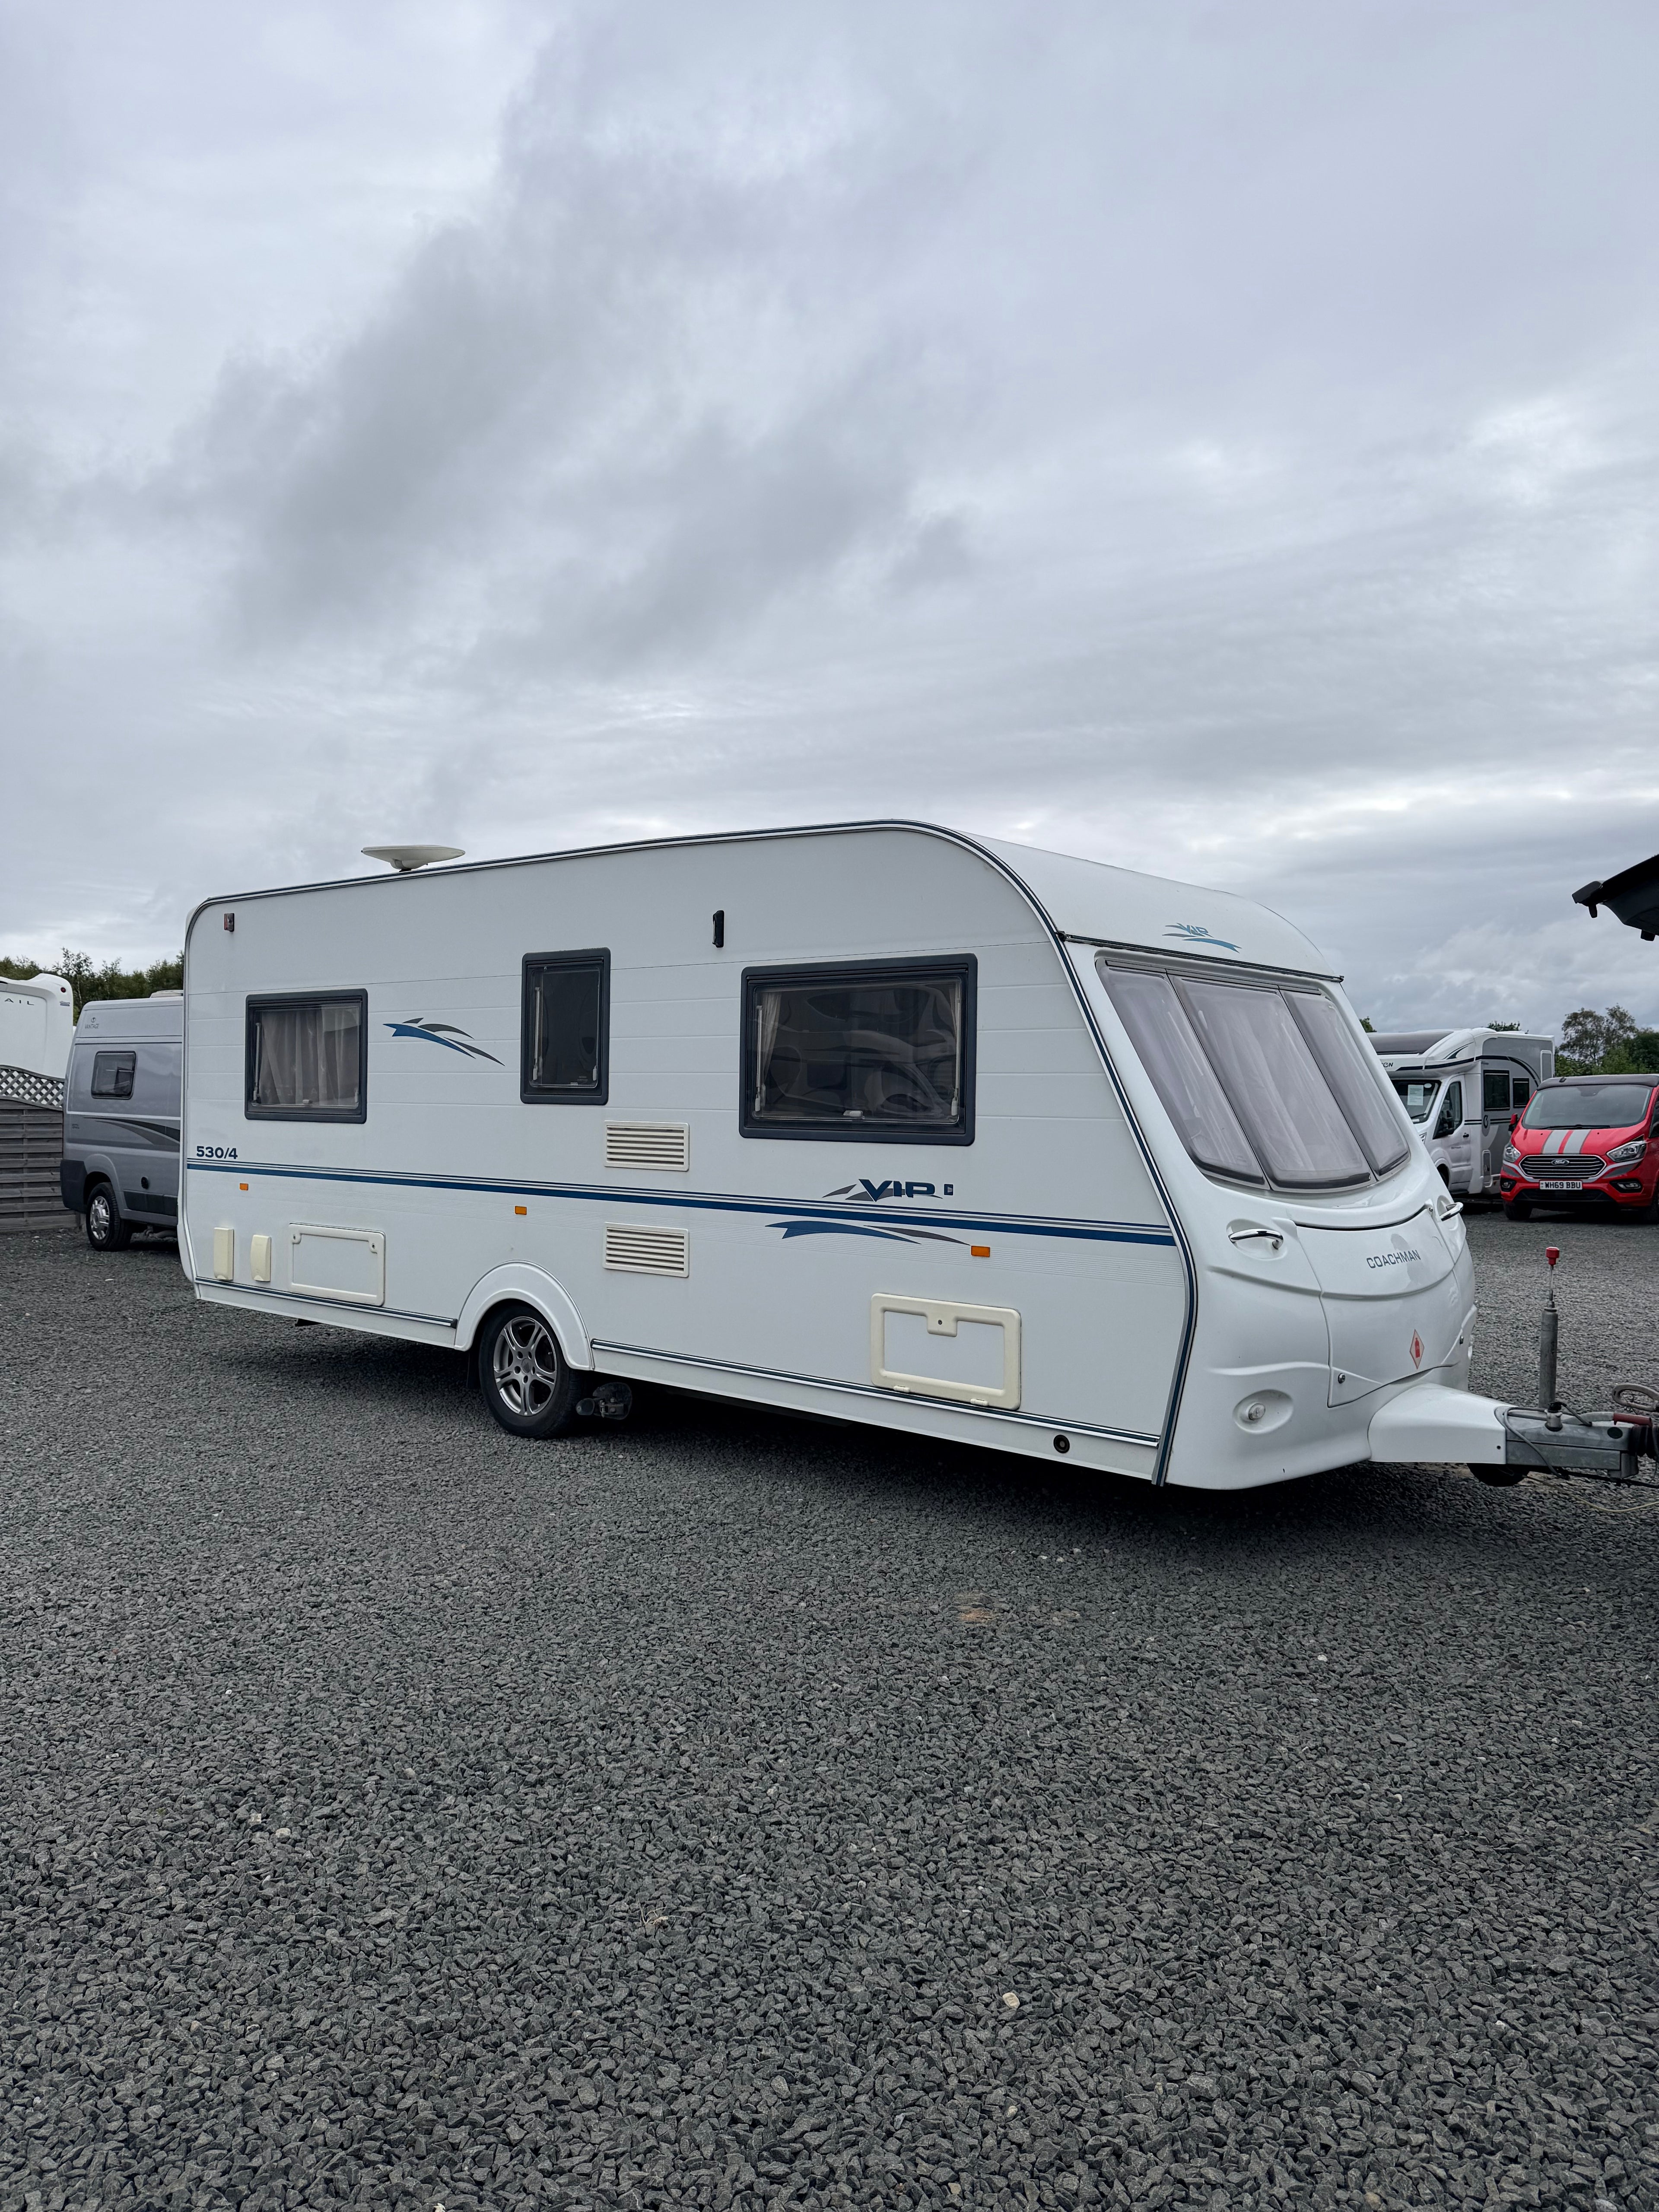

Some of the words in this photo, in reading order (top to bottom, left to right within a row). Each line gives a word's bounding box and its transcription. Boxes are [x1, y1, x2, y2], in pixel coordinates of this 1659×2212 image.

[1176, 923, 1209, 934] VIP
[196, 1146, 238, 1159] 530/4
[858, 1179, 935, 1202] VIP
[1366, 1250, 1421, 1268] COACHMAN
